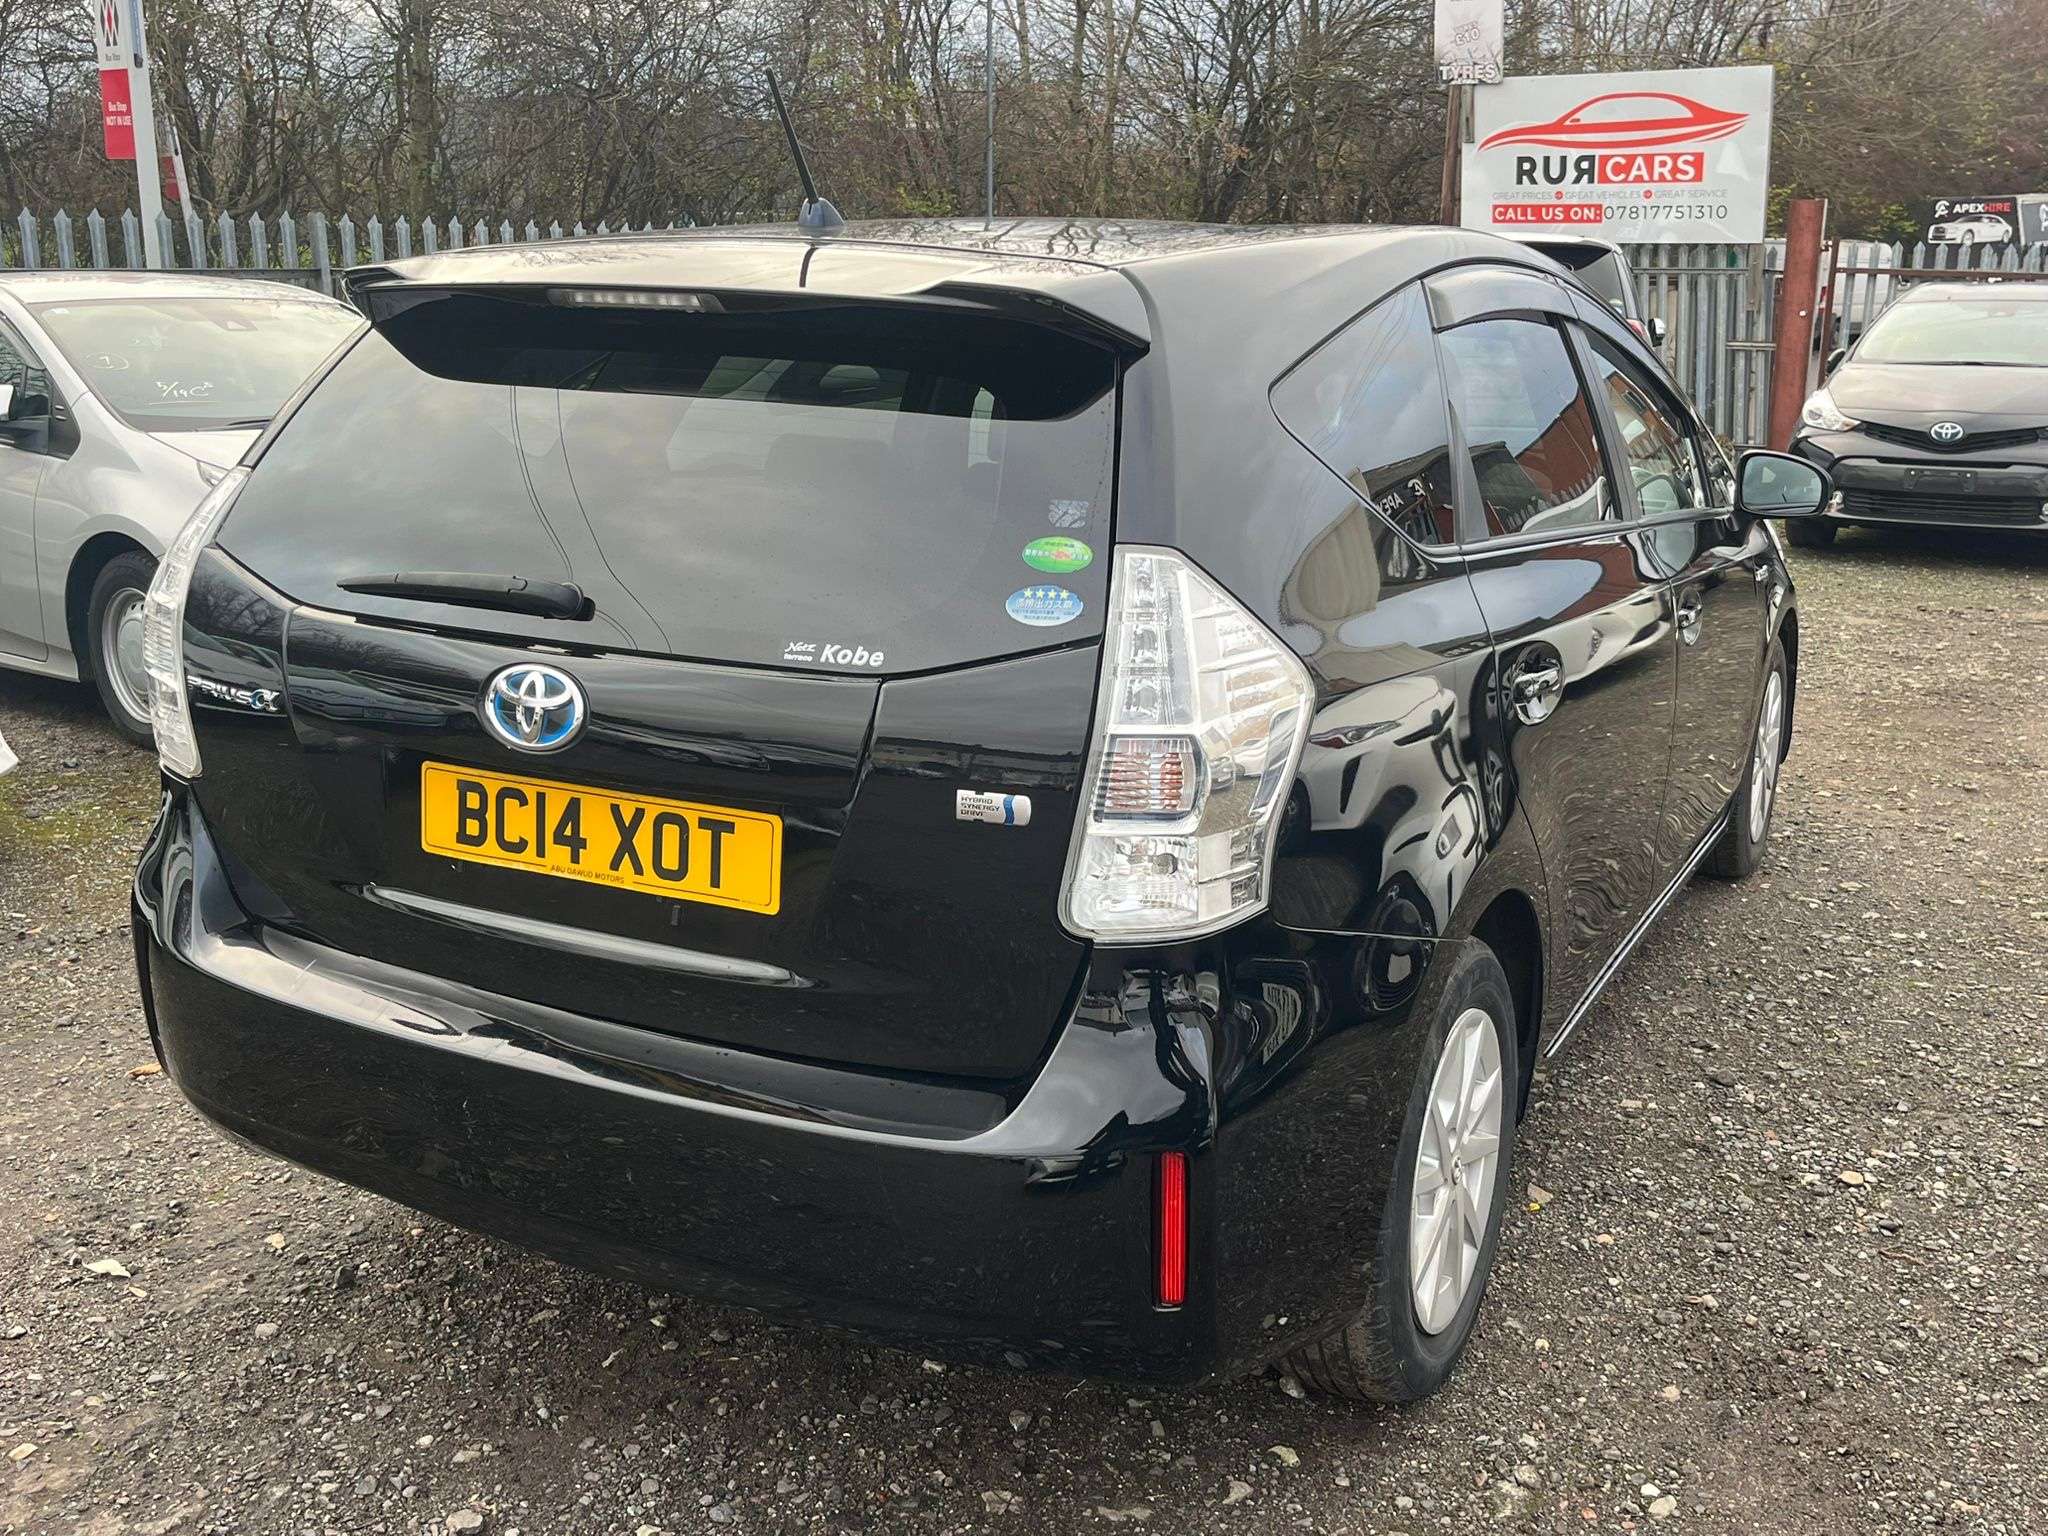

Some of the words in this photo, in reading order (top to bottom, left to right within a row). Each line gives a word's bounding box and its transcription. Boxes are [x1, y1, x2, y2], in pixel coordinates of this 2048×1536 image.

[1440, 63, 1496, 80] TYRES
[108, 101, 116, 112] Bus
[116, 101, 127, 113] Stop
[106, 116, 116, 126] NOT
[123, 115, 132, 126] USE
[1606, 155, 1696, 182] CARS
[1493, 191, 1520, 200] GREAT
[1521, 191, 1552, 200] PRICES
[1565, 190, 1594, 200] GREAT
[1595, 190, 1641, 199] VEHICLES
[1655, 189, 1686, 199] GREAT
[1687, 189, 1728, 198] SERVICE
[1494, 207, 1536, 220] CALL
[1541, 207, 1564, 220] US
[1569, 207, 1600, 220] ON:
[1603, 204, 1728, 220] 07817751310
[784, 642, 817, 653] Netz
[820, 643, 884, 667] Kobe
[960, 796, 993, 805] HYBRID
[960, 802, 1000, 812] SYNERGY
[456, 778, 588, 865] BC14
[609, 803, 736, 889] XOT
[551, 864, 566, 873] ABU
[595, 872, 625, 884] MOTORS
